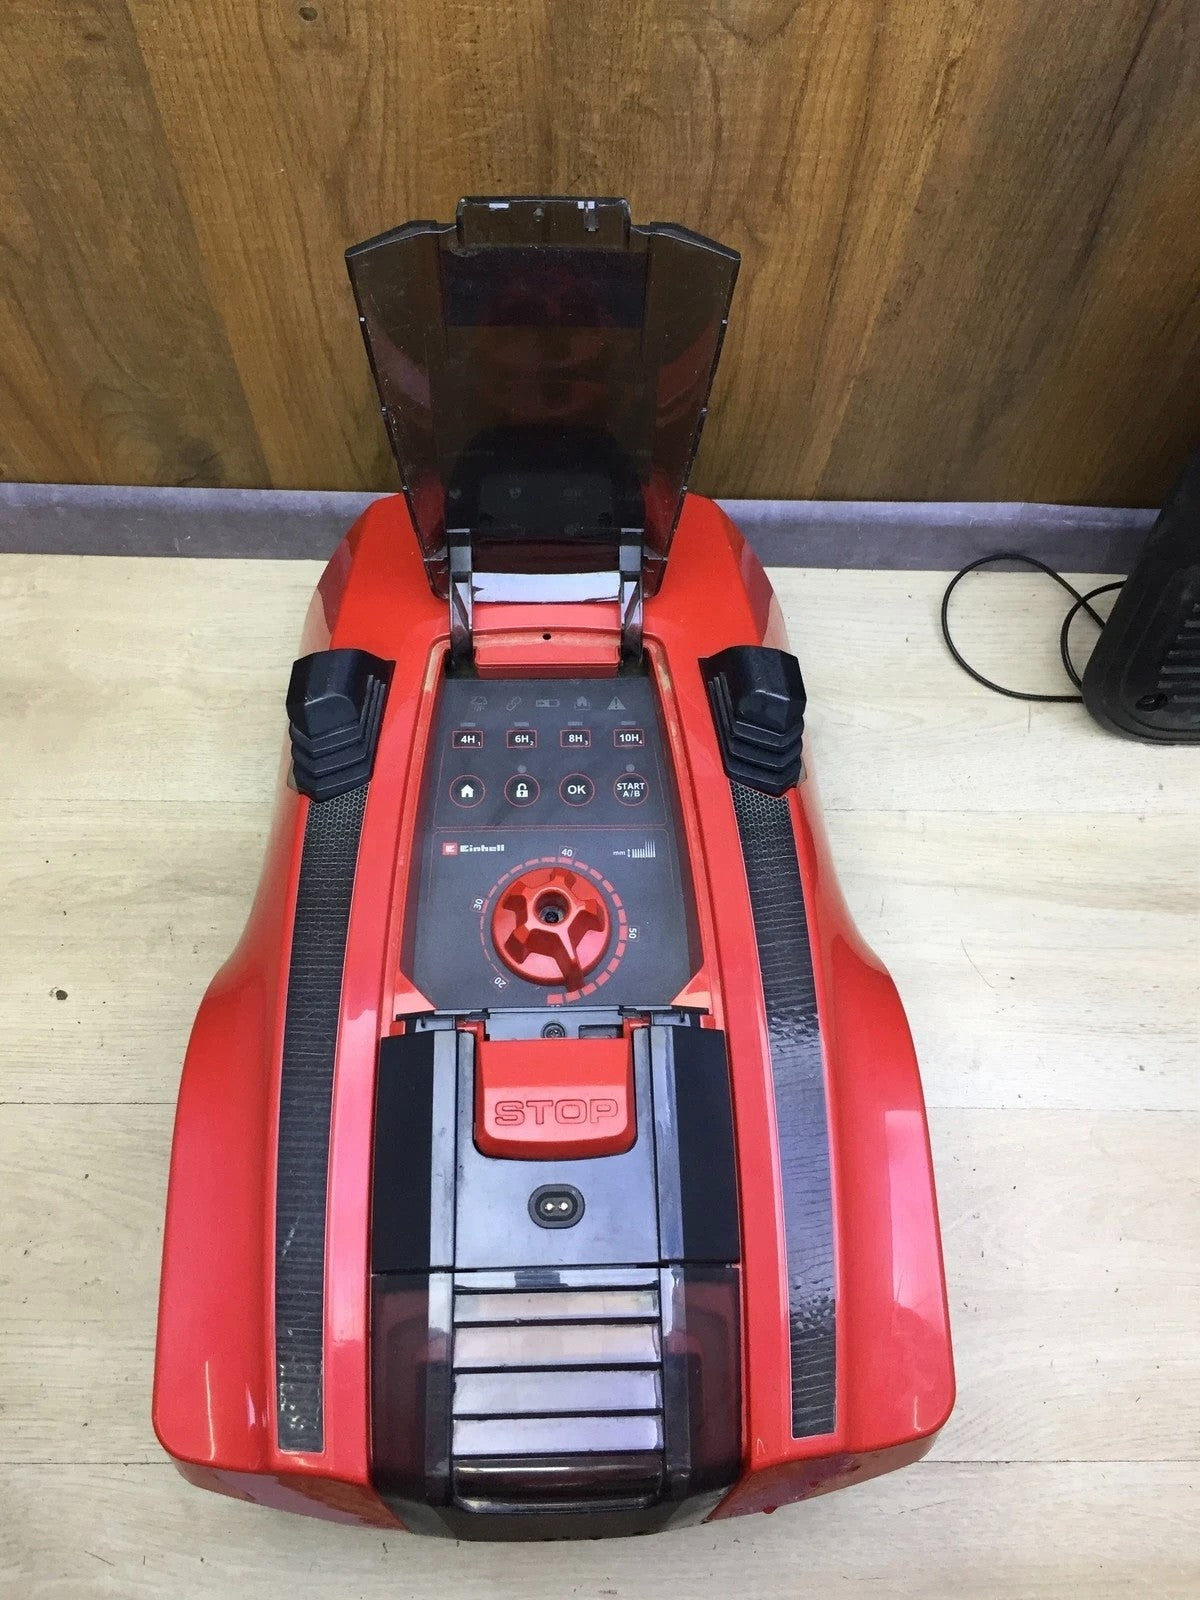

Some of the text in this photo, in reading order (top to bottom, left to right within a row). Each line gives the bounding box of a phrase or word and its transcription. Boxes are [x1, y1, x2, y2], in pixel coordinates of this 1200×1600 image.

[460, 734, 475, 743] 4H
[514, 734, 529, 743] 6H
[568, 733, 583, 743] 8H
[619, 733, 639, 742] 10H
[567, 785, 587, 795] OK
[616, 782, 645, 791] START
[622, 790, 641, 798] A/B
[460, 844, 505, 853] Einhell
[561, 849, 574, 857] 40
[473, 898, 484, 911] 30
[628, 927, 638, 940] 50
[494, 976, 507, 989] 20
[494, 1098, 619, 1127] STOP
